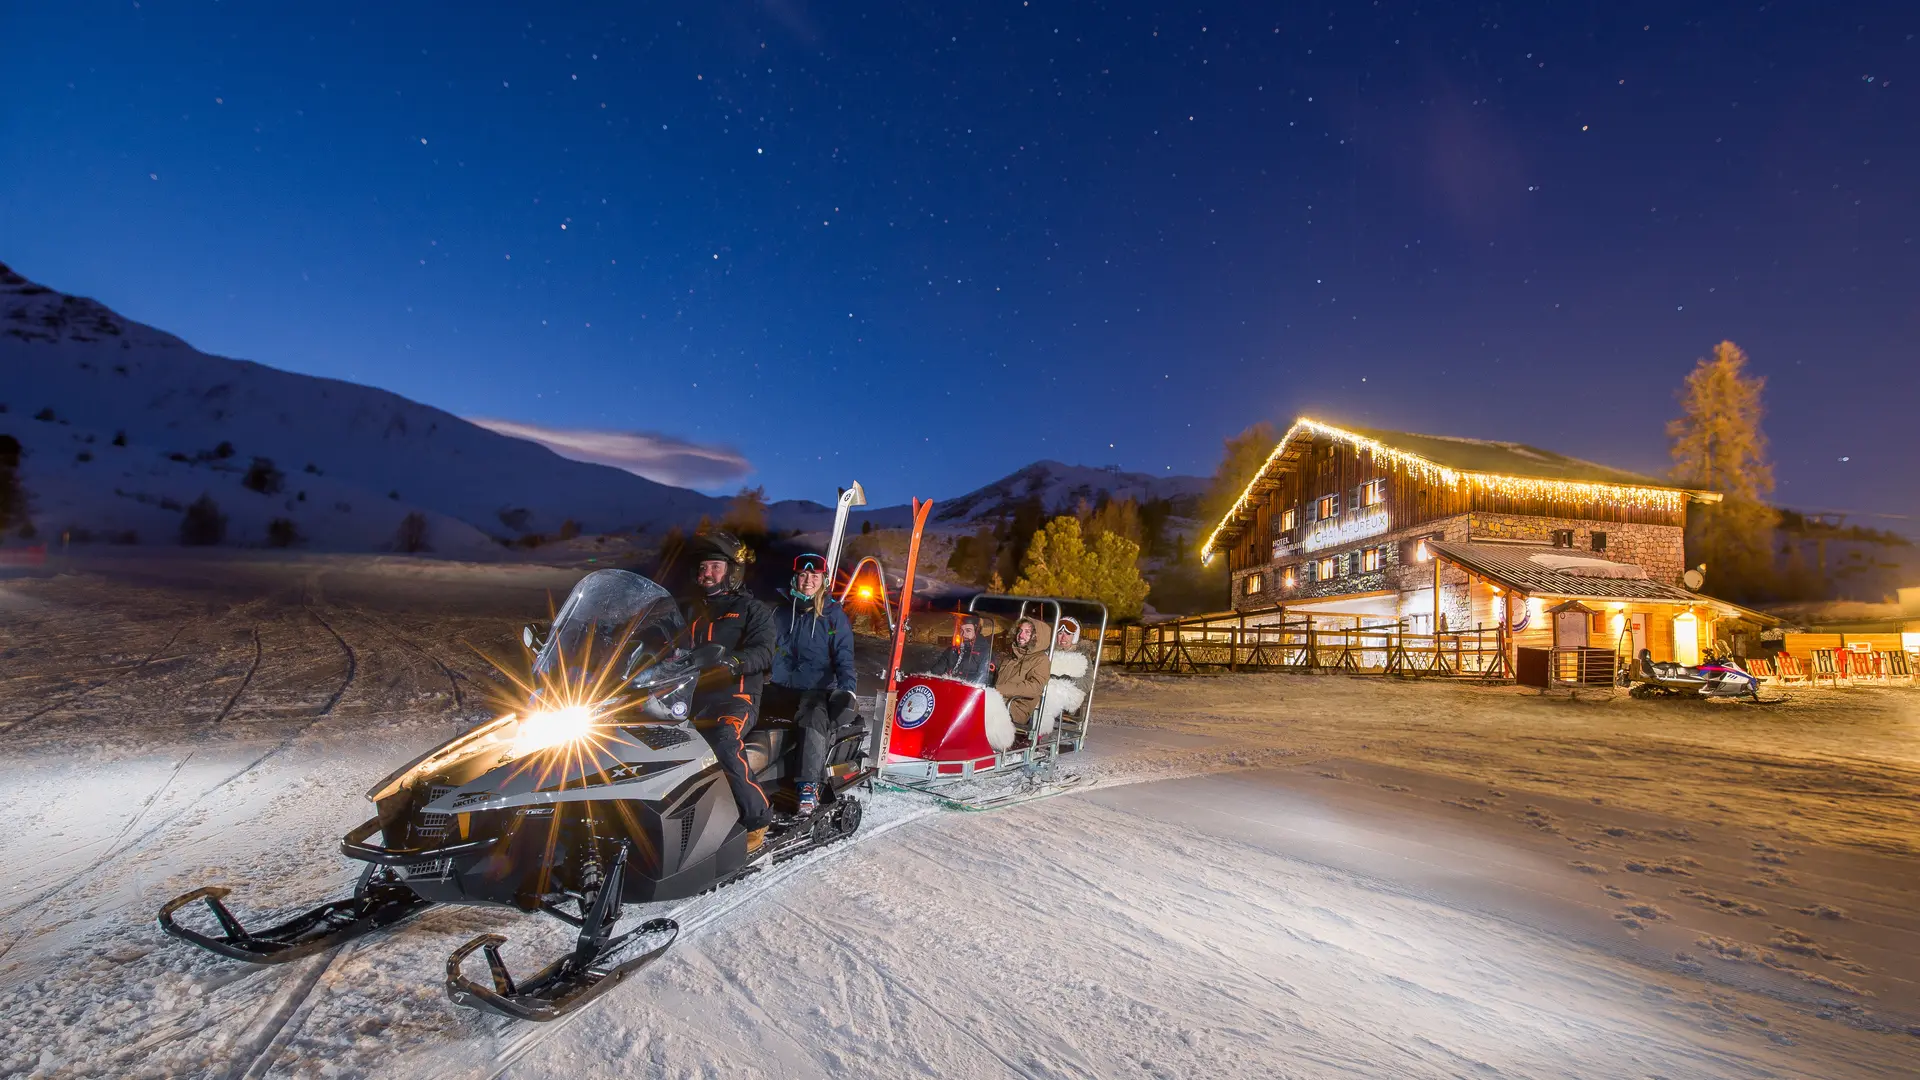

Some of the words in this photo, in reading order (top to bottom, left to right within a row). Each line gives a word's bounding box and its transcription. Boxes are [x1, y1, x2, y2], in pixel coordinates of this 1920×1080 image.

[1272, 536, 1289, 547] HOTEL
[611, 765, 642, 778] XT
[452, 797, 477, 808] ARCTIC
